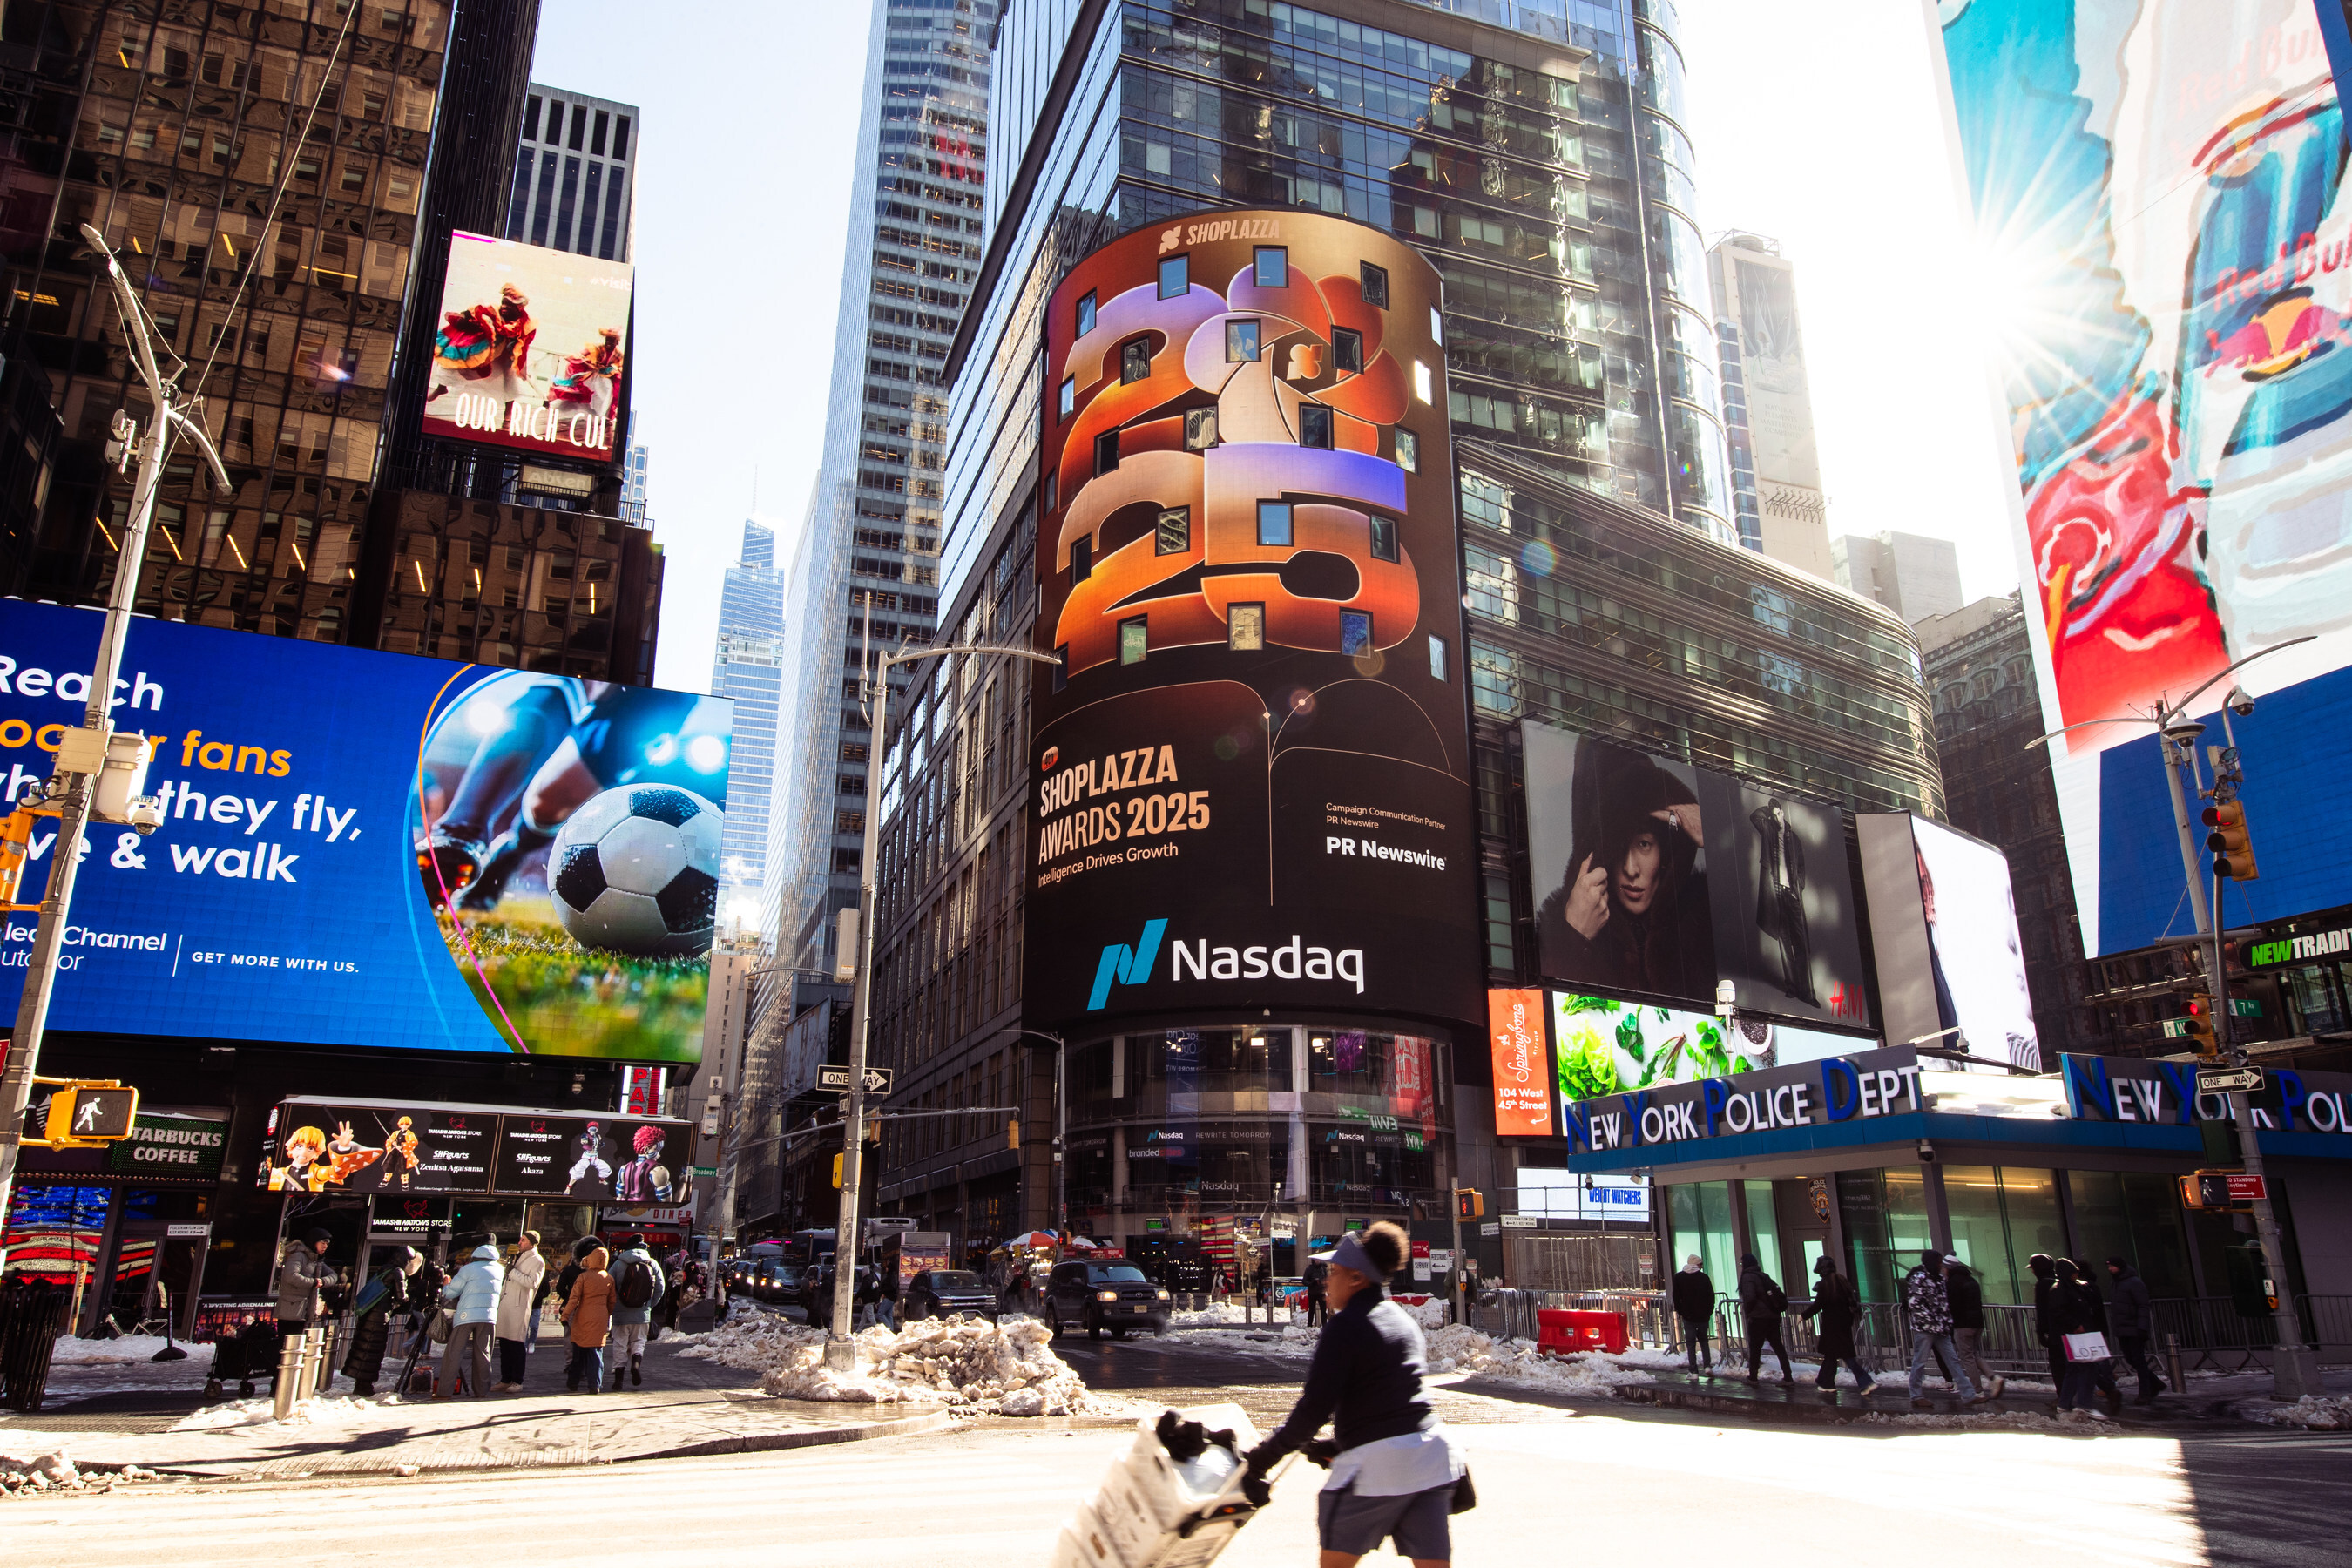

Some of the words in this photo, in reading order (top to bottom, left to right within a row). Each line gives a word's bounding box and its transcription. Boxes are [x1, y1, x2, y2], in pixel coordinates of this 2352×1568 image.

[1186, 219, 1280, 246] SHOPLAZZA
[2213, 241, 2288, 313] Red
[455, 392, 498, 432] OUR
[509, 401, 558, 443] RICH
[570, 412, 608, 451] CUL
[0, 655, 164, 712] Reach
[180, 730, 293, 777] fans
[1040, 744, 1178, 817] SHOPLAZZA
[158, 779, 277, 835] they
[292, 793, 362, 842] fly,
[1326, 802, 1367, 815] Campaign
[1369, 807, 1423, 825] Communication
[1424, 817, 1446, 830] Partner
[1326, 815, 1338, 824] PR
[1340, 817, 1379, 828] Newswire
[1038, 802, 1121, 865] AWARDS
[1126, 790, 1210, 837] 2025
[110, 832, 147, 870] &
[170, 842, 300, 883] walk
[1326, 836, 1355, 856] PR
[1362, 839, 1446, 871] Newswire
[1037, 861, 1083, 889] Intelligence
[1086, 852, 1123, 870] Drives
[1126, 841, 1179, 862] Growth
[61, 925, 167, 951] Channel
[191, 951, 224, 964] GET
[231, 954, 279, 968] MORE
[286, 957, 328, 971] WITH
[334, 960, 360, 973] US.
[1173, 935, 1365, 995] Nasdaq
[1829, 980, 1863, 1024] H&M
[2240, 1002, 2247, 1014] 7
[2176, 1022, 2186, 1035] W
[1507, 1003, 1533, 1083] Springbone
[828, 1074, 849, 1084] ONE
[2061, 1052, 2161, 1123] NEW
[2203, 1078, 2223, 1087] ONE
[2232, 1074, 2254, 1085] WAY
[1498, 1088, 1517, 1098] 104
[1518, 1088, 1544, 1098] West
[1498, 1099, 1517, 1110] 45th
[1519, 1099, 1548, 1110] Street
[1565, 1101, 1621, 1154] NEW
[1622, 1092, 1700, 1146] YORK
[1703, 1078, 1813, 1137] POLICE
[1821, 1058, 1919, 1122] DEPT
[132, 1126, 222, 1146] TARBUCKS
[1159, 1132, 1184, 1140] Nasdaq
[1339, 1132, 1365, 1142] Nasdaq
[133, 1146, 200, 1164] COFFEE
[420, 1163, 447, 1172] Zenitsu
[448, 1165, 483, 1173] Agatsuma
[521, 1166, 544, 1175] Akaza
[693, 1166, 716, 1177] Broadway
[1201, 1180, 1239, 1192] Nasdaq
[1612, 1189, 1642, 1206] WATCHERS
[653, 1209, 692, 1220] DINER
[2075, 1345, 2106, 1358] LOFT
